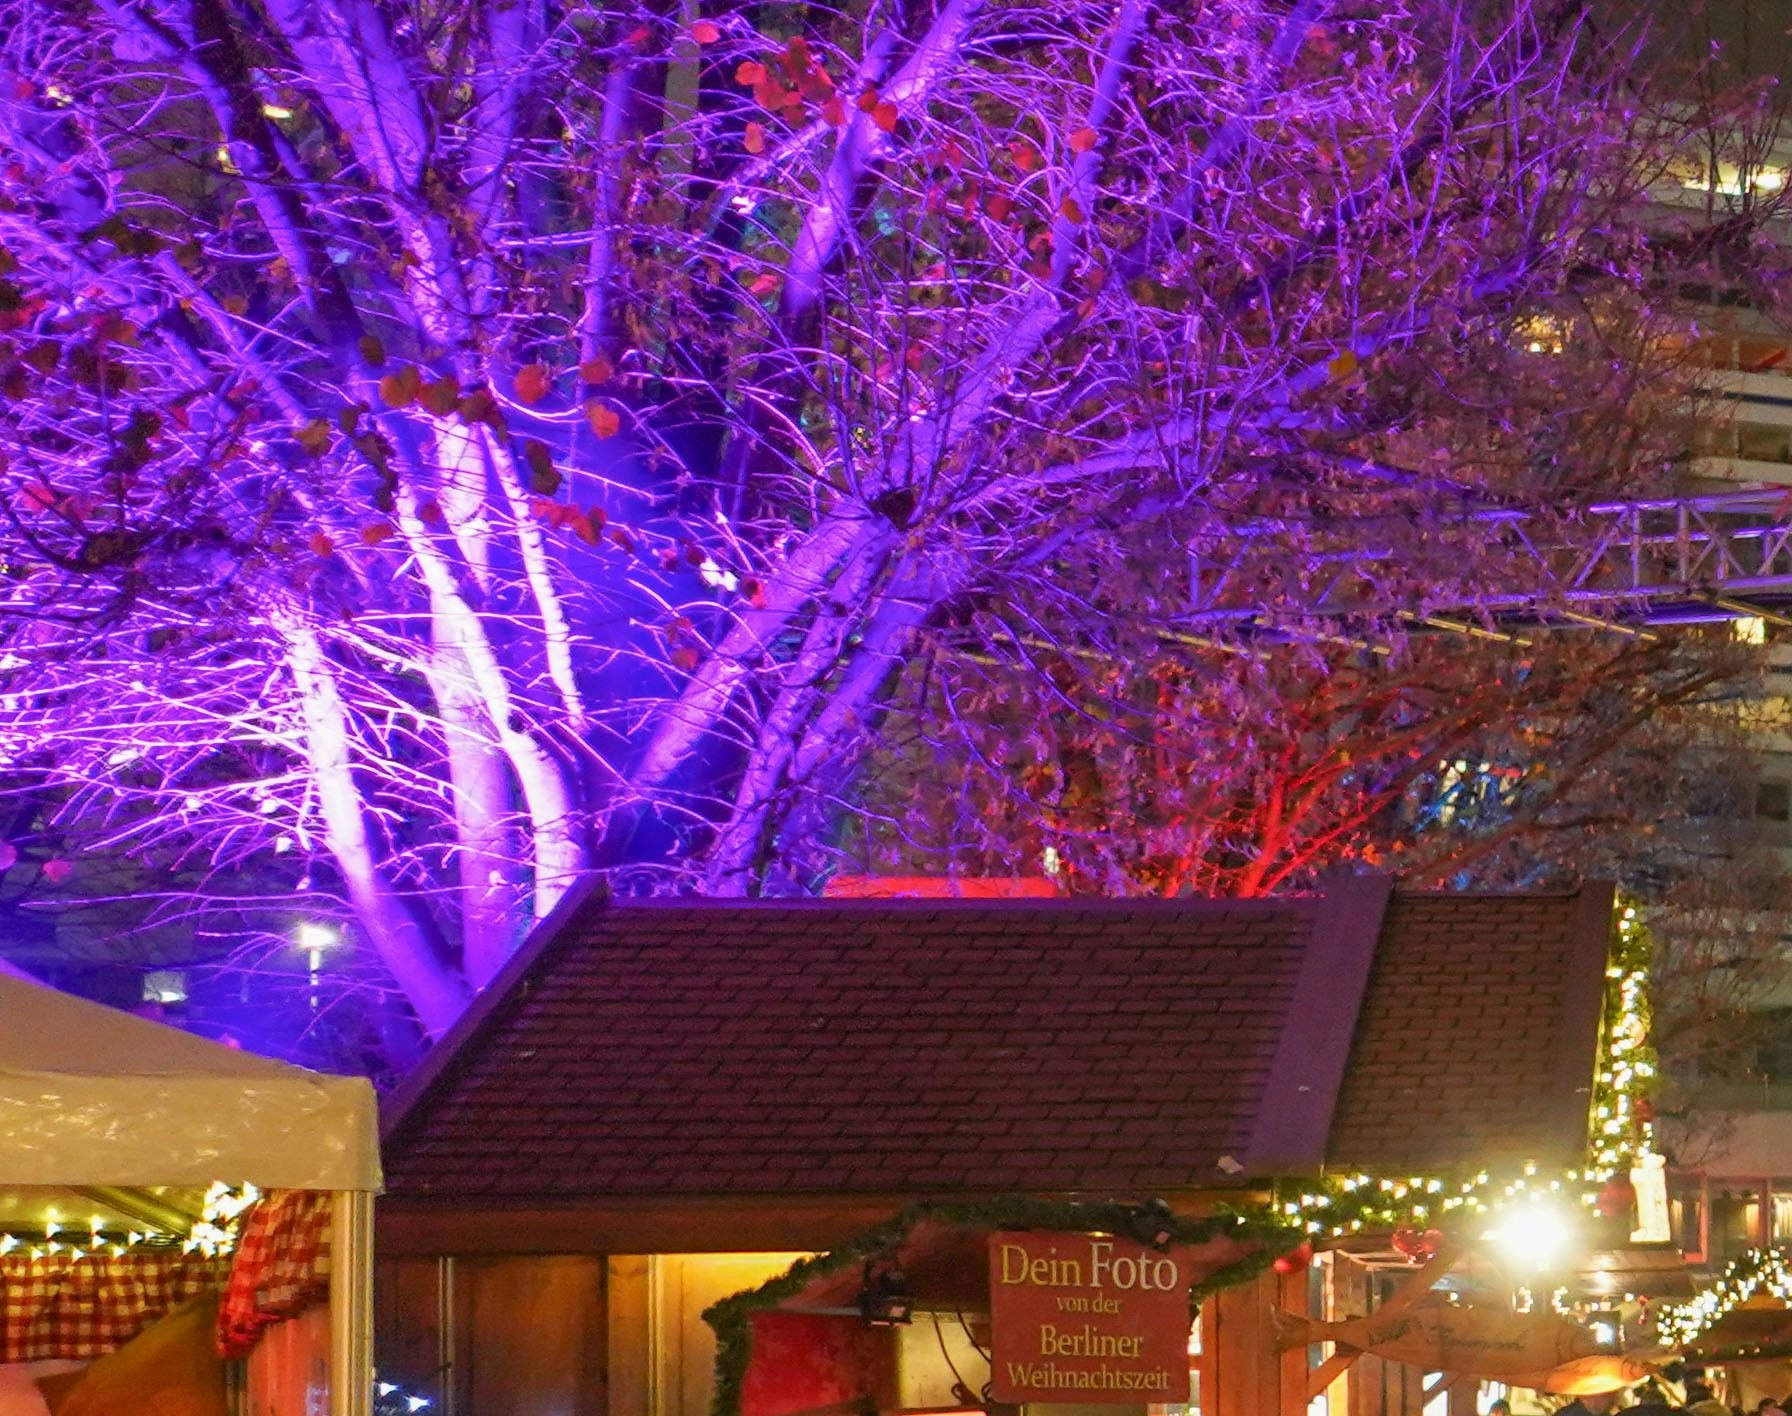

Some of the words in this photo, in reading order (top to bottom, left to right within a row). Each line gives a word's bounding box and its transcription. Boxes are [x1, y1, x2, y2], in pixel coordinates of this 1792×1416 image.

[1000, 1244, 1083, 1287] Dein
[1089, 1241, 1178, 1291] Foto
[1056, 1297, 1090, 1313] von
[1092, 1292, 1122, 1314] der
[1040, 1324, 1144, 1358] Berliner
[1007, 1361, 1170, 1390] Weihnachtszeit
